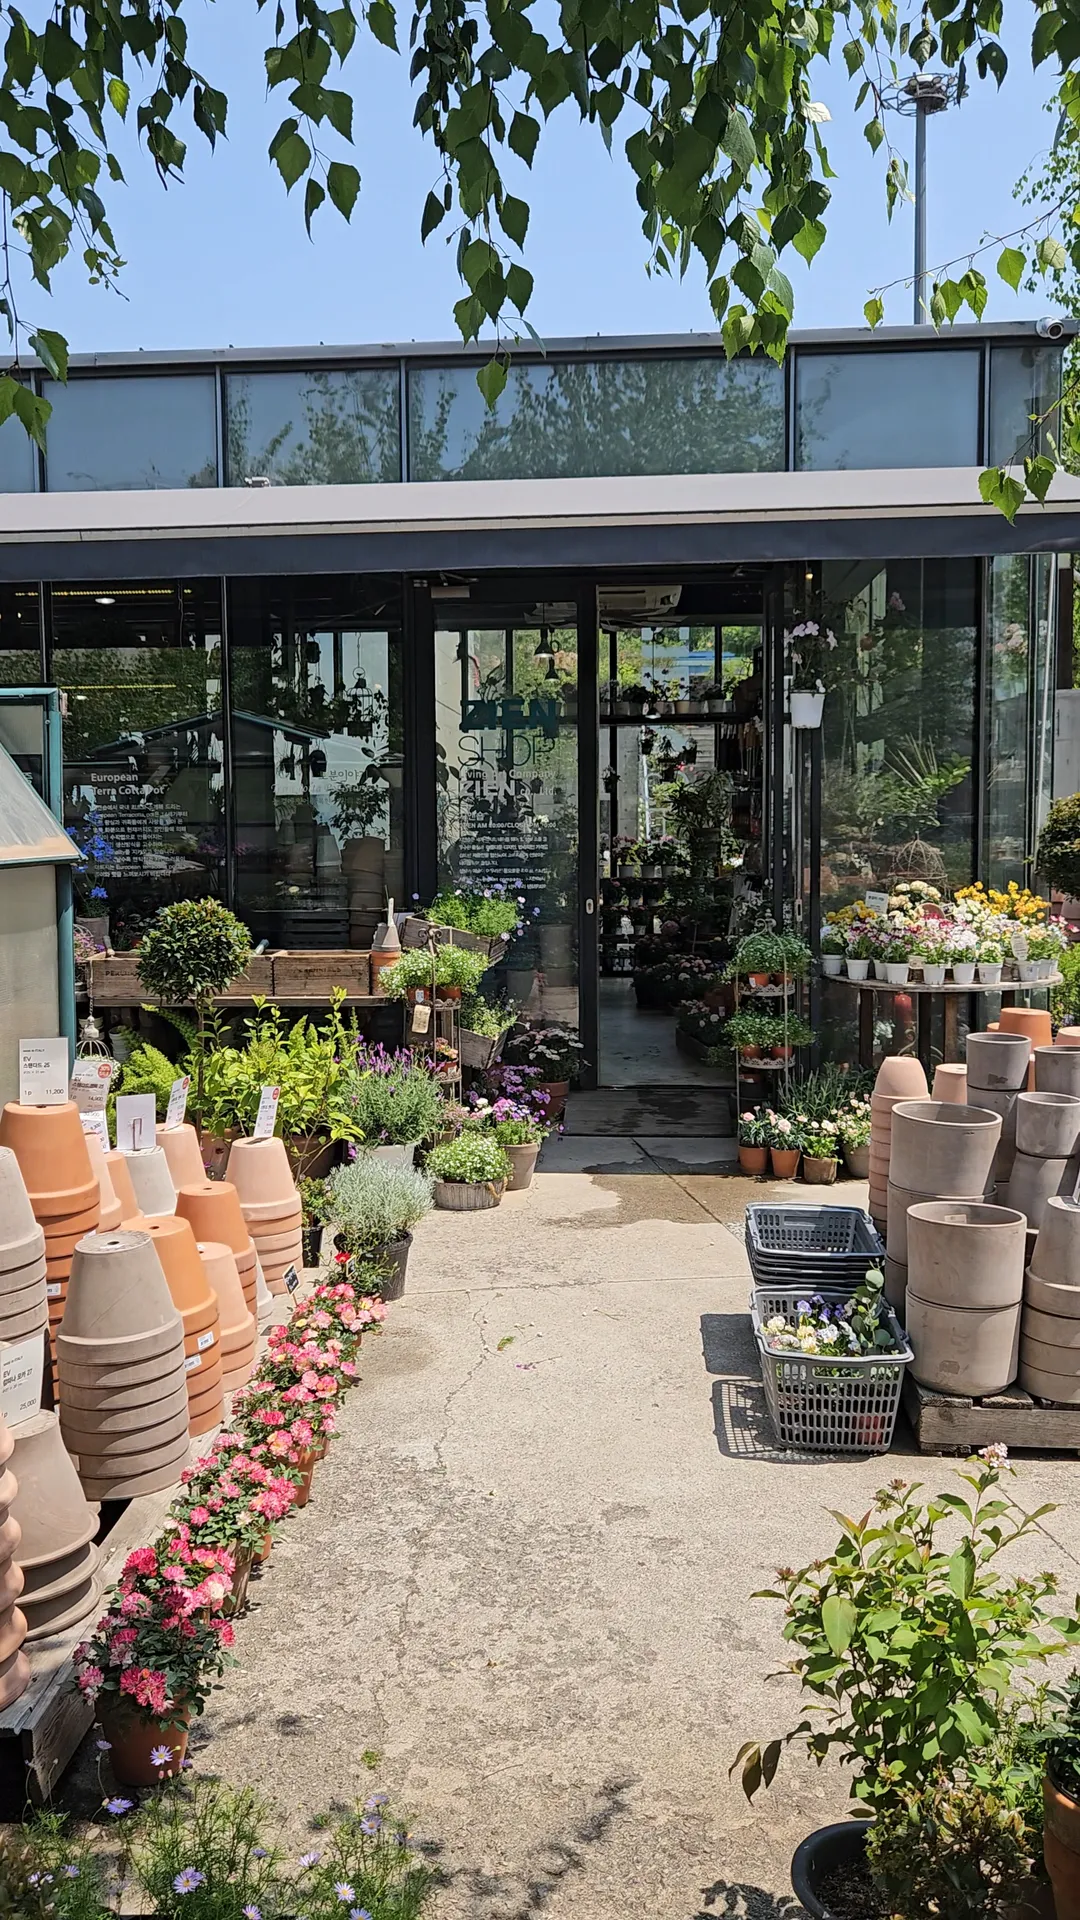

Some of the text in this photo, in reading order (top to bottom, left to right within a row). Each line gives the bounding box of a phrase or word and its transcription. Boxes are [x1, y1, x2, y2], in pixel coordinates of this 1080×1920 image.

[460, 699, 556, 731] ZIEN
[90, 773, 139, 783] European
[319, 769, 368, 782] 분이야
[459, 768, 488, 780] ving
[508, 769, 556, 781] Company
[92, 786, 117, 796] Terra
[460, 780, 515, 796] ZIEN
[3, 1369, 12, 1378] EV
[19, 1397, 37, 1411] 25,000
